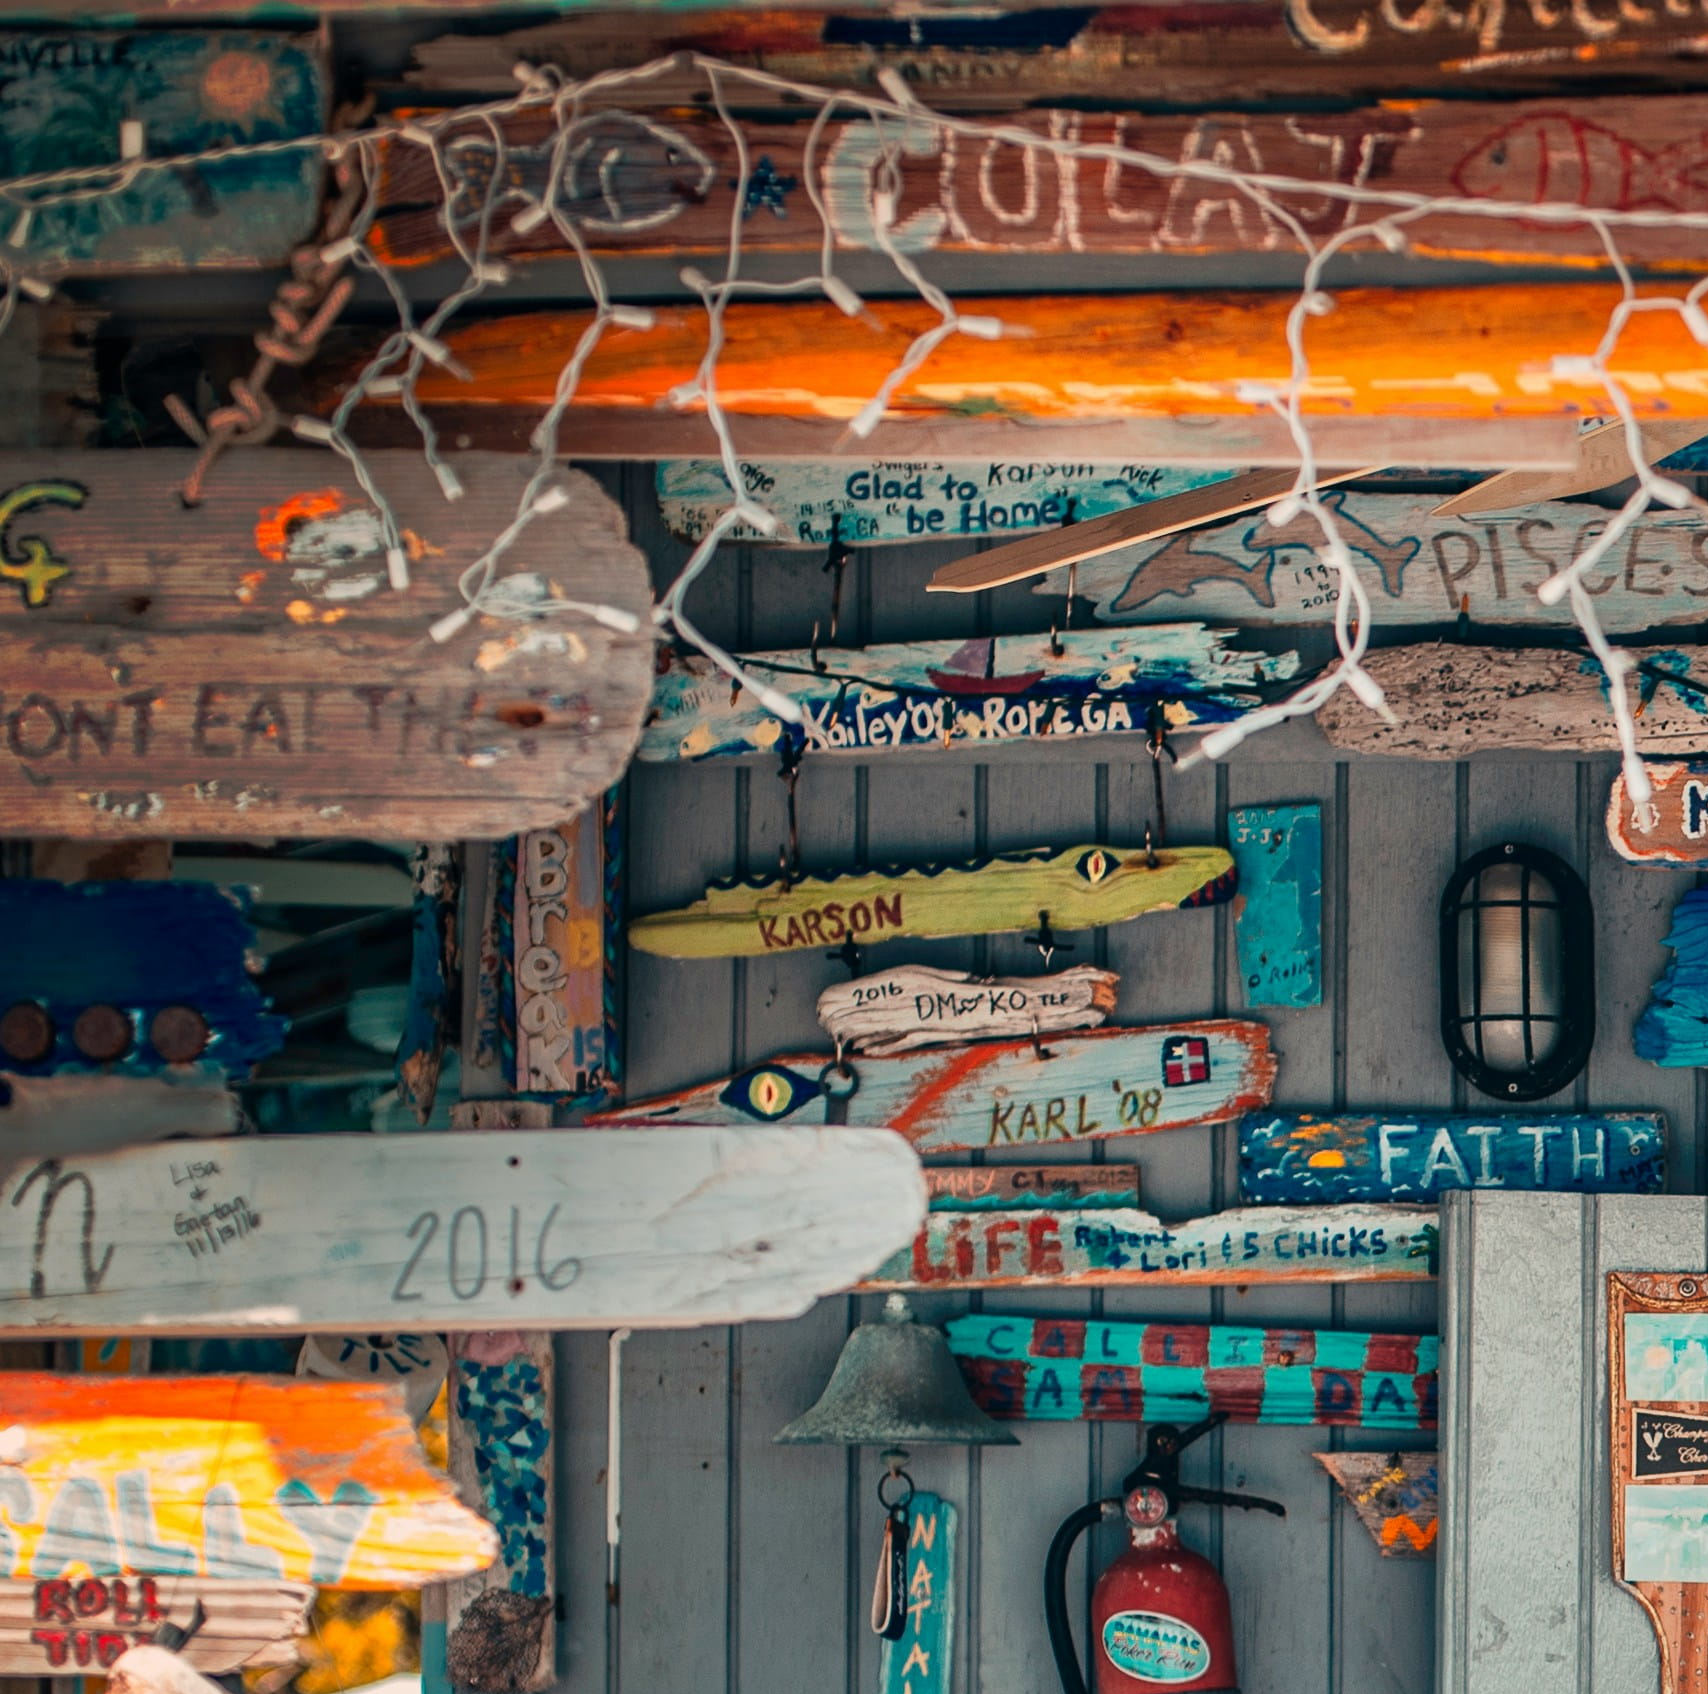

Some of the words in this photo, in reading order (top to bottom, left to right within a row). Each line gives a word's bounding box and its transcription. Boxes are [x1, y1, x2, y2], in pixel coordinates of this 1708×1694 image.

[845, 468, 925, 502] Glad
[938, 472, 978, 502] to
[802, 697, 907, 750] Kailey
[758, 891, 905, 949] KARSON
[987, 1100, 1100, 1146] KARL
[1377, 1122, 1610, 1189] FAITH
[392, 1201, 583, 1303] 2016
[33, 1576, 167, 1626] ROLL
